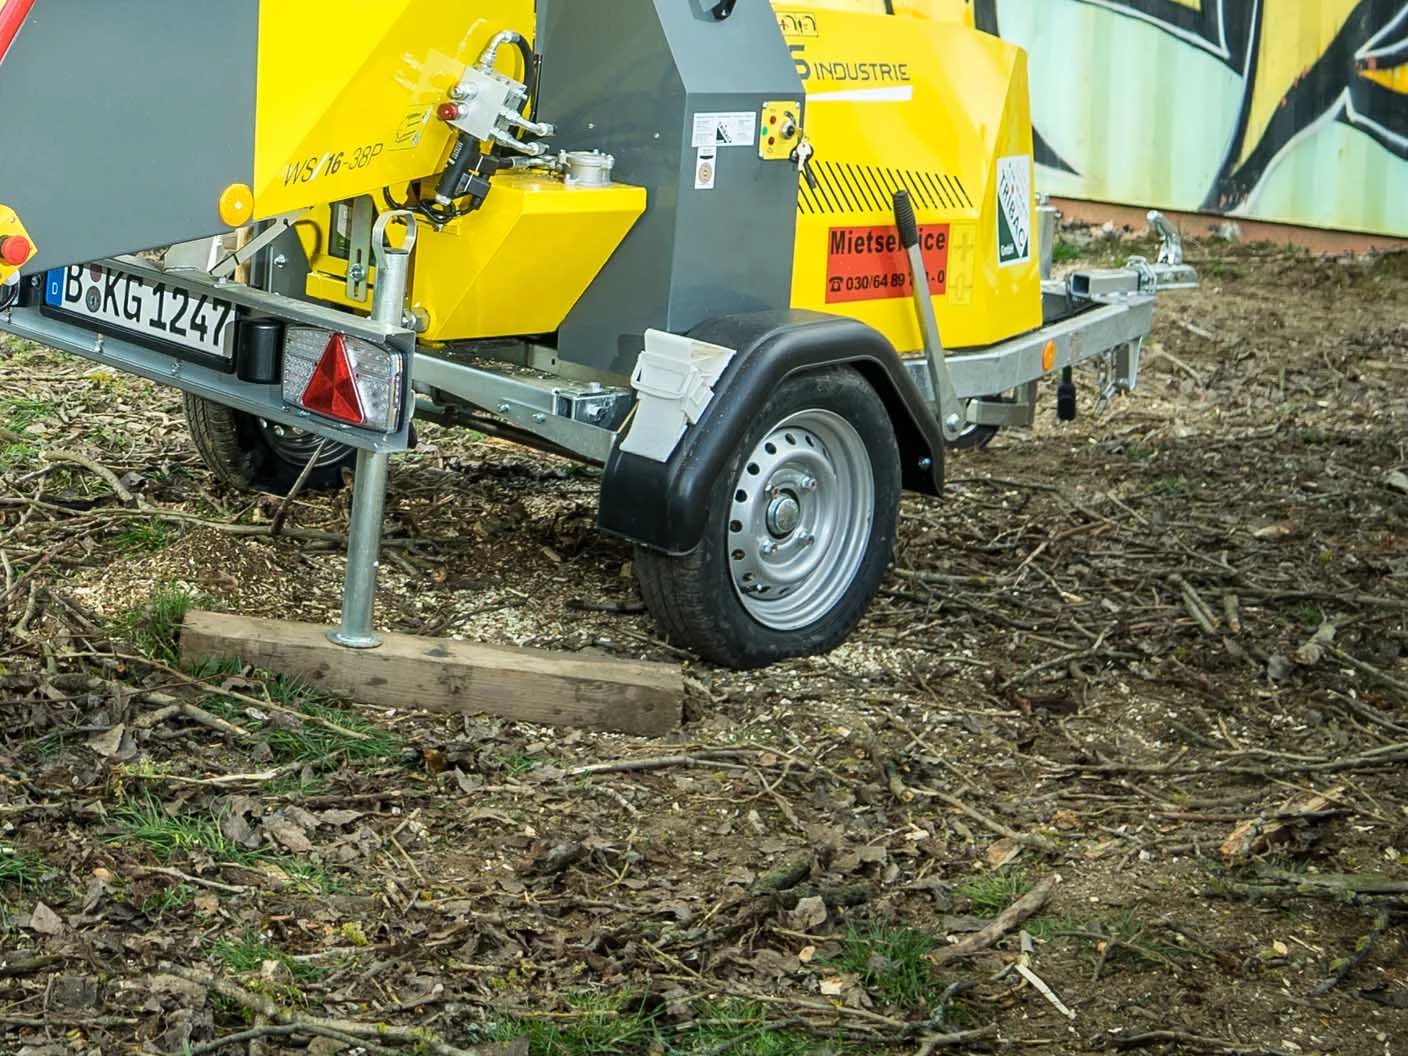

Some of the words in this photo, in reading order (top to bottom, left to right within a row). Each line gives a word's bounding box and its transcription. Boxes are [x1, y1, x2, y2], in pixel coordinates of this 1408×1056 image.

[814, 63, 911, 81] INDUSTRIE
[1000, 168, 1026, 248] TRIBAC
[830, 227, 946, 255] Mietseice
[51, 281, 58, 295] D
[891, 273, 906, 288] 89
[65, 264, 84, 303] B
[102, 267, 143, 323] KG
[149, 281, 233, 347] 1247
